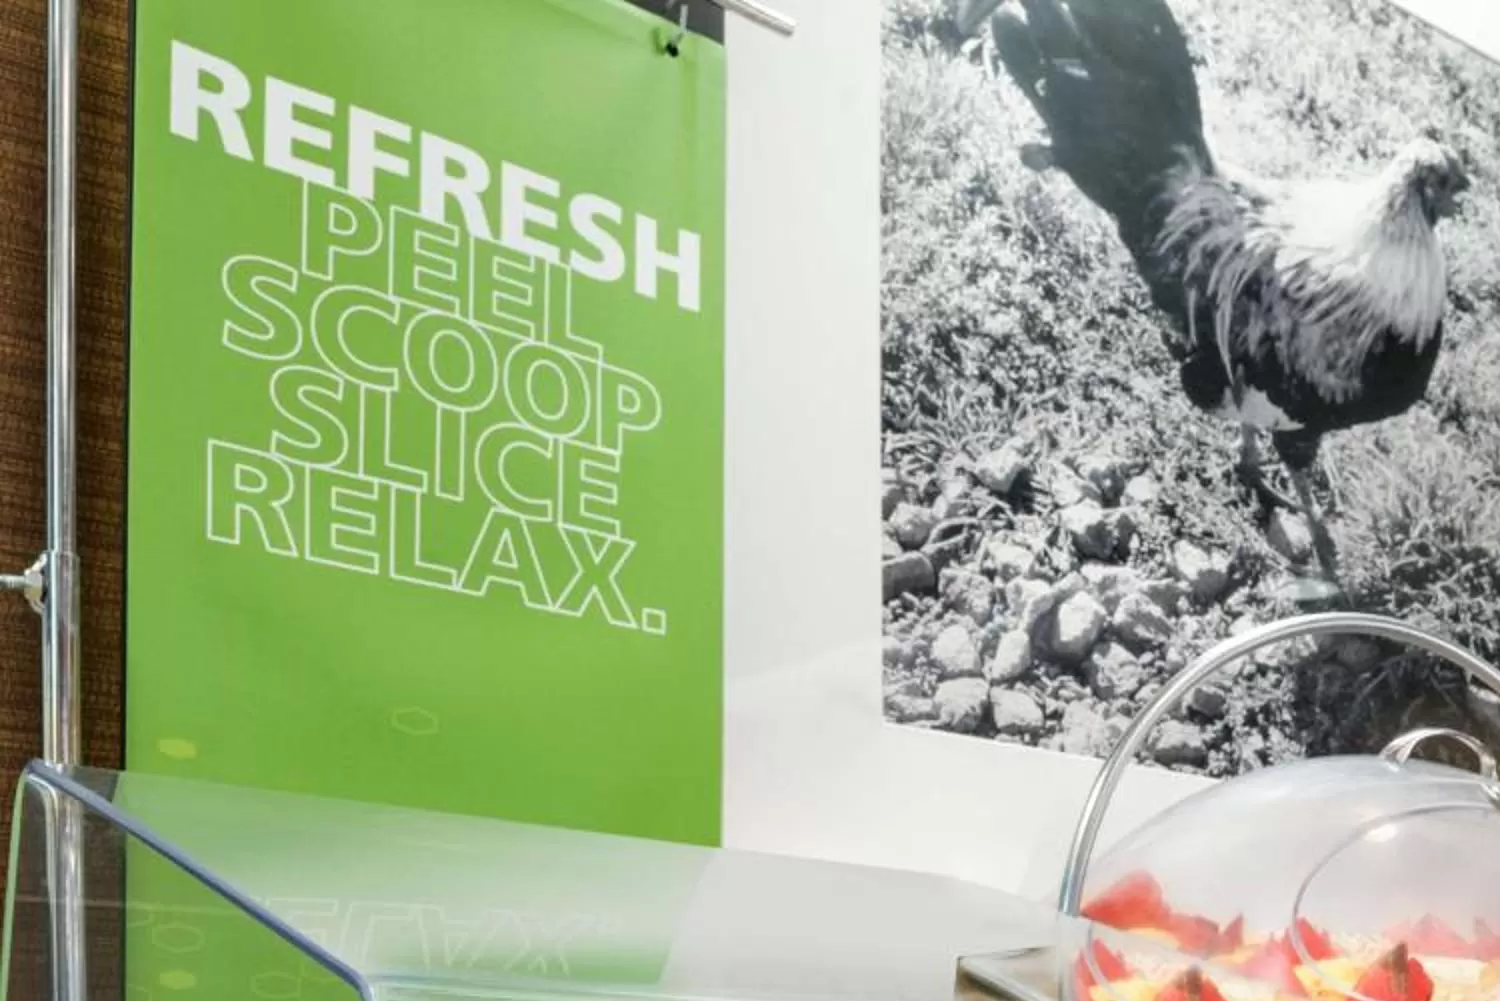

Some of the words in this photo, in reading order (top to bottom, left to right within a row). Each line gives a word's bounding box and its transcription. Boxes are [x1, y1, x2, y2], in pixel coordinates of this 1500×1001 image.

[170, 39, 701, 313] REFRESH
[301, 178, 603, 364] PEEL
[221, 254, 662, 456] SCOOP
[269, 364, 621, 538] SLICE
[207, 438, 667, 635] RELAX.
